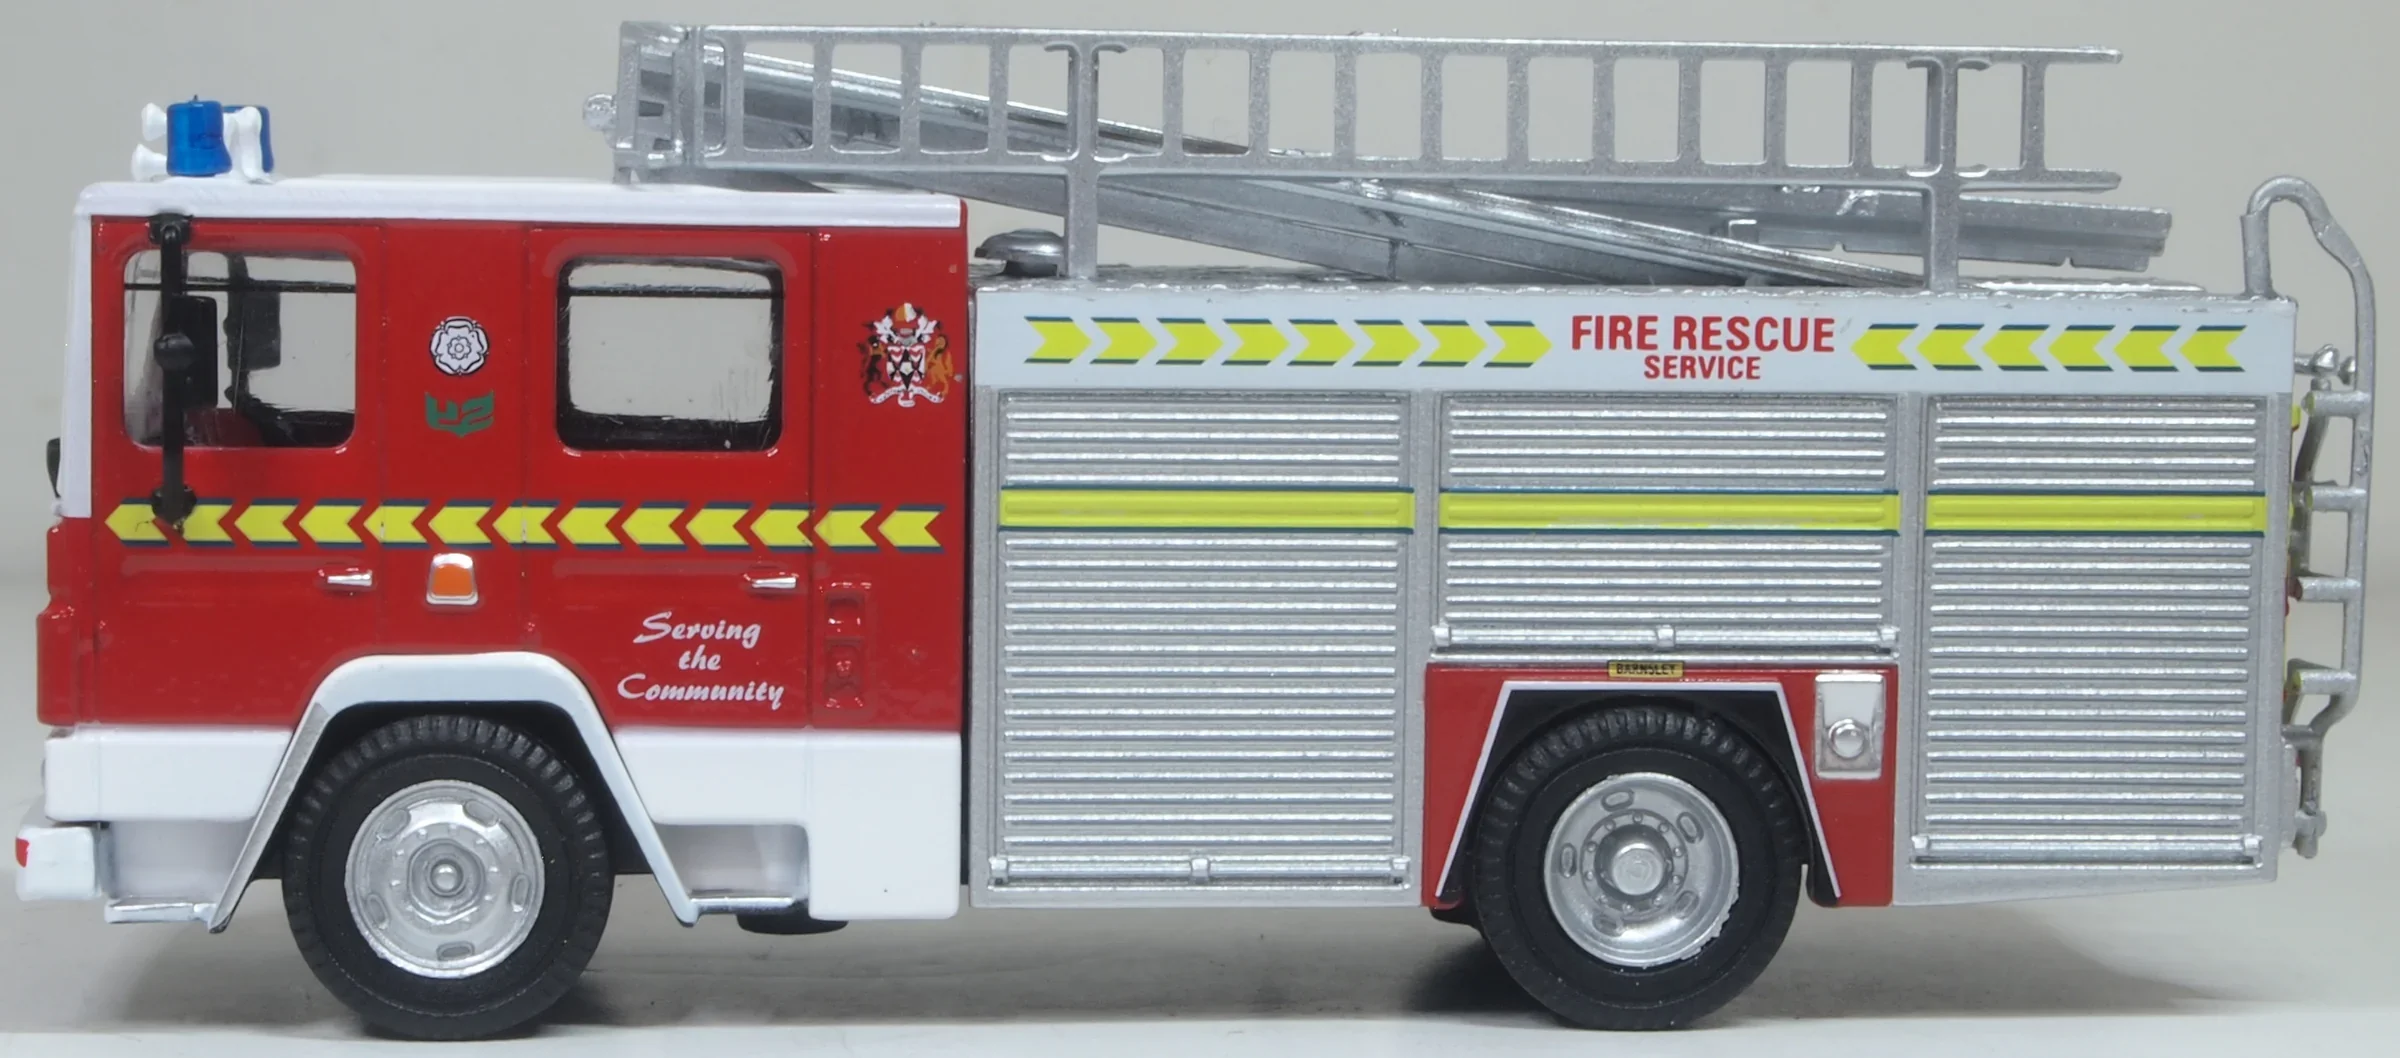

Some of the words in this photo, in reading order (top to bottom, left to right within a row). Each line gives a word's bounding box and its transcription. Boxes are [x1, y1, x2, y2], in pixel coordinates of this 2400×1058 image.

[1572, 315, 1658, 350] FIRE
[1673, 316, 1835, 352] RESCUE
[1643, 355, 1761, 379] SERVICE
[633, 611, 761, 649] Serving
[678, 644, 721, 670] the
[1615, 662, 1676, 676] BARNSLEY
[617, 673, 784, 710] Community
